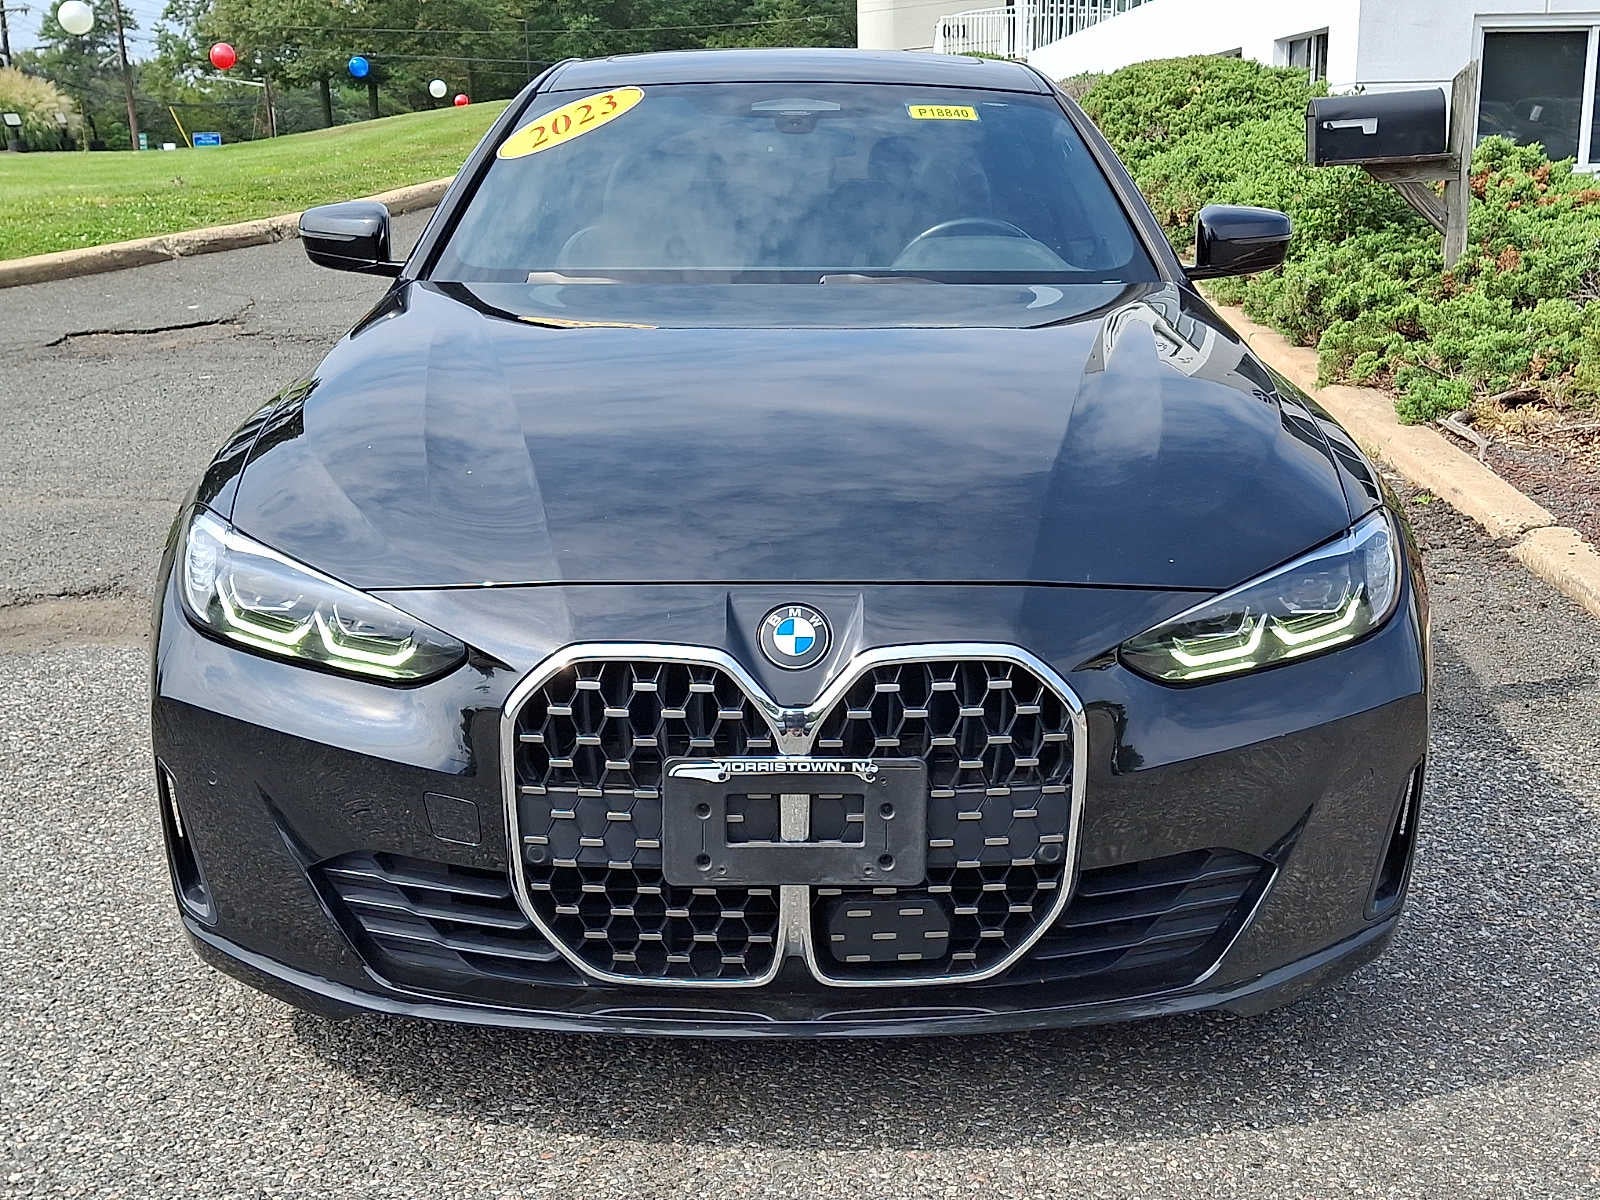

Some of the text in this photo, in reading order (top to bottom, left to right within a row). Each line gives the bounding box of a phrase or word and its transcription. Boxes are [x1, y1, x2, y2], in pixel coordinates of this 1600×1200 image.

[529, 94, 617, 148] 2023
[918, 108, 969, 118] P18840
[767, 607, 823, 627] BMW
